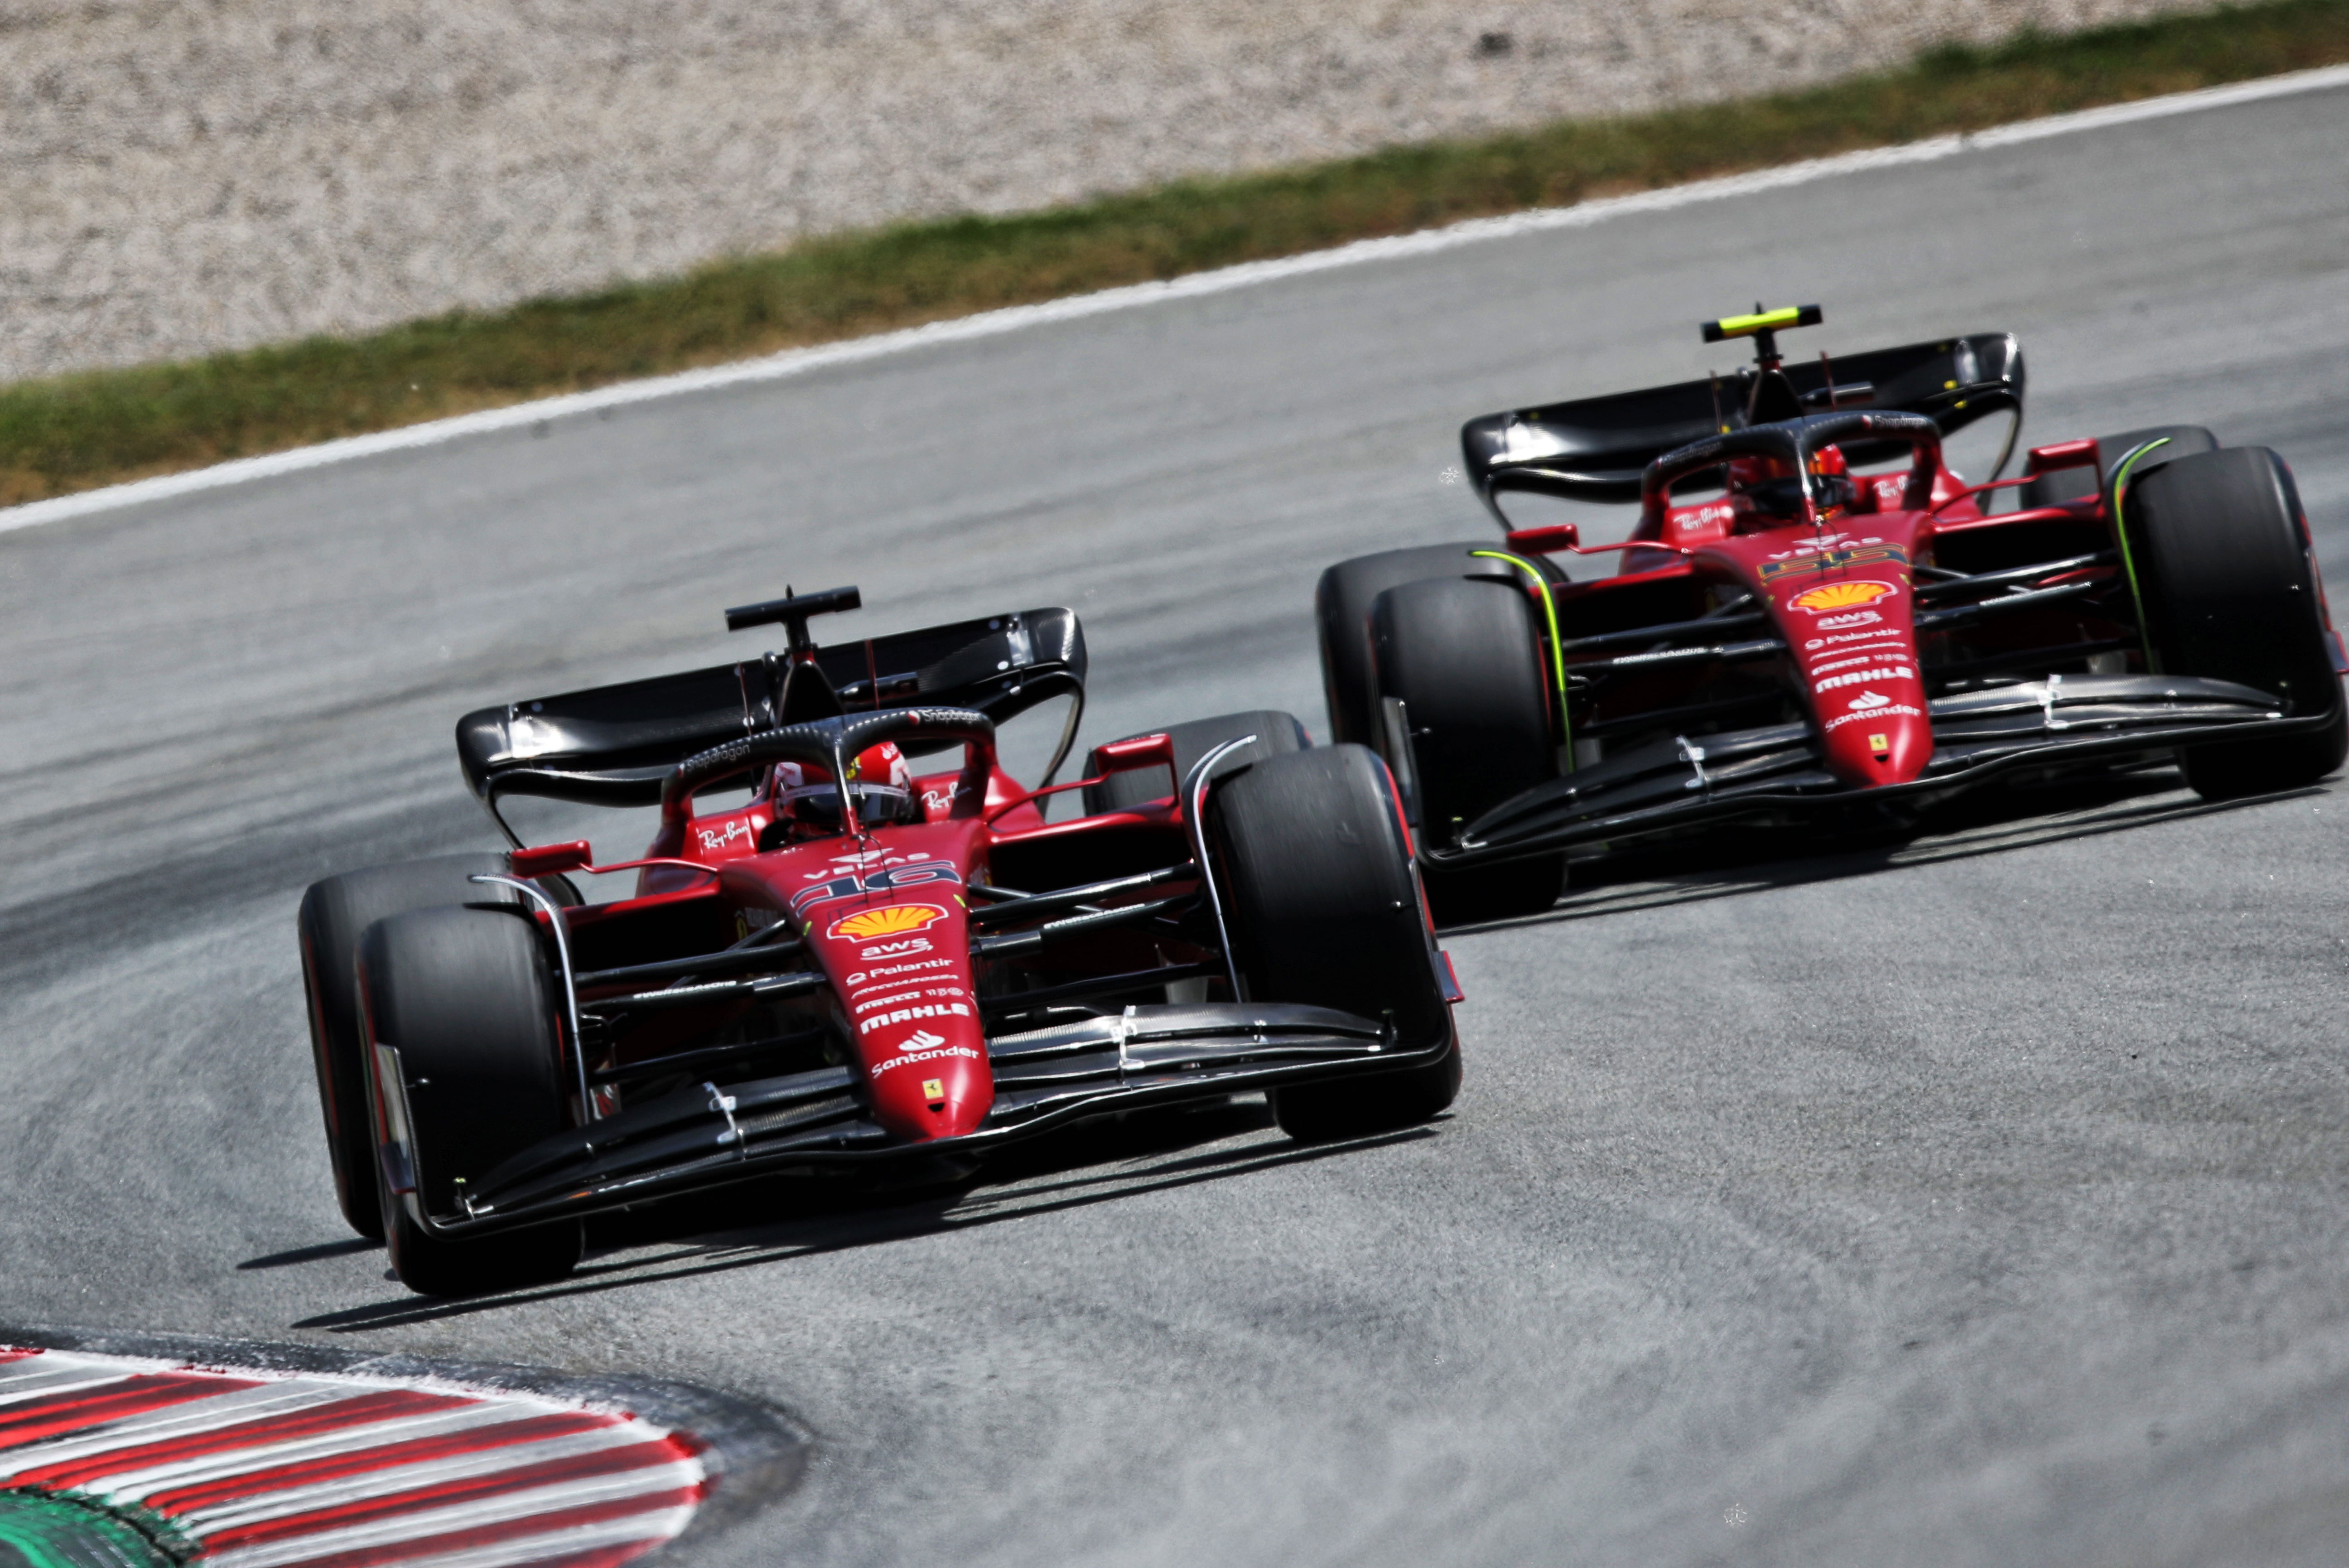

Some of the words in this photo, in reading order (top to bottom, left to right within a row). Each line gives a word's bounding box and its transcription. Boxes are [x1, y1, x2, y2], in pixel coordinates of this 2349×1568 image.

[1757, 542, 1910, 586] 55
[1817, 610, 1880, 627] aws
[1826, 628, 1902, 644] Palantir
[1815, 666, 1914, 694] MAHLE
[918, 709, 982, 724] Snapdragon
[1825, 704, 1922, 733] Santander
[686, 744, 751, 772] Snapdragon
[698, 821, 749, 849] Ray-Ban
[803, 852, 931, 879] VELAS
[790, 860, 962, 919] 16
[861, 937, 930, 957] aws
[869, 958, 954, 978] Palantir
[860, 1003, 970, 1035] MAHLE
[871, 1045, 979, 1079] Santander
